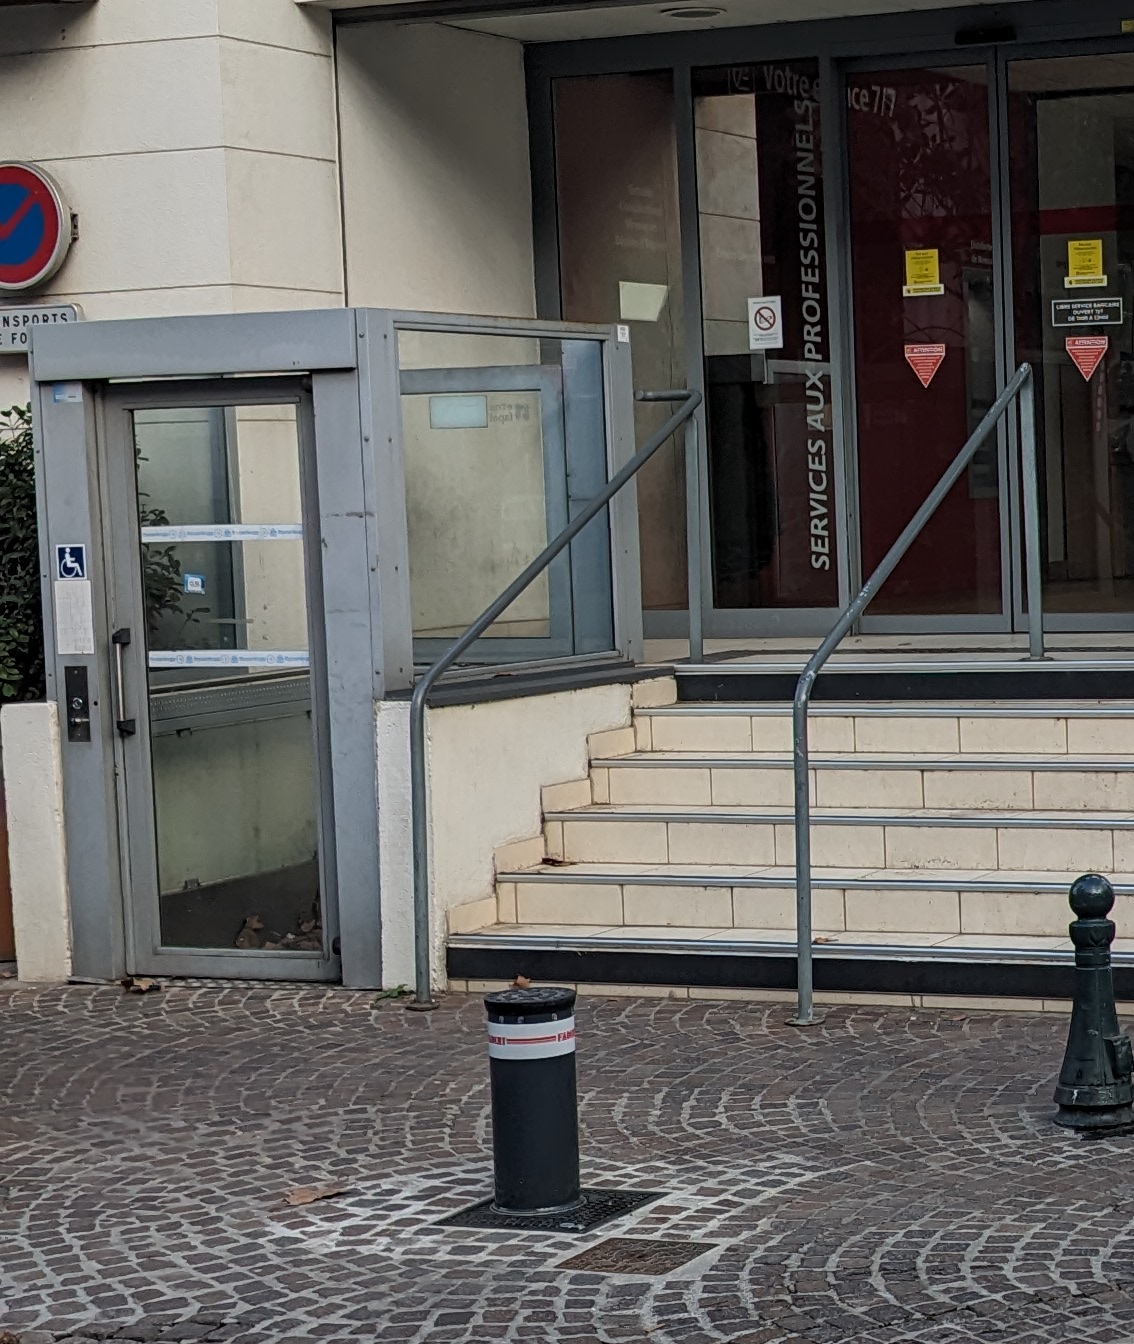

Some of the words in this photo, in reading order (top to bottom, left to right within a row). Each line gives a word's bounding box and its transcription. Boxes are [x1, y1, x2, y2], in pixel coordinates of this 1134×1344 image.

[763, 64, 811, 98] Votre
[794, 99, 824, 361] PROFESSIONNELS
[803, 369, 827, 432] AUX
[807, 439, 830, 571] SERVICES
